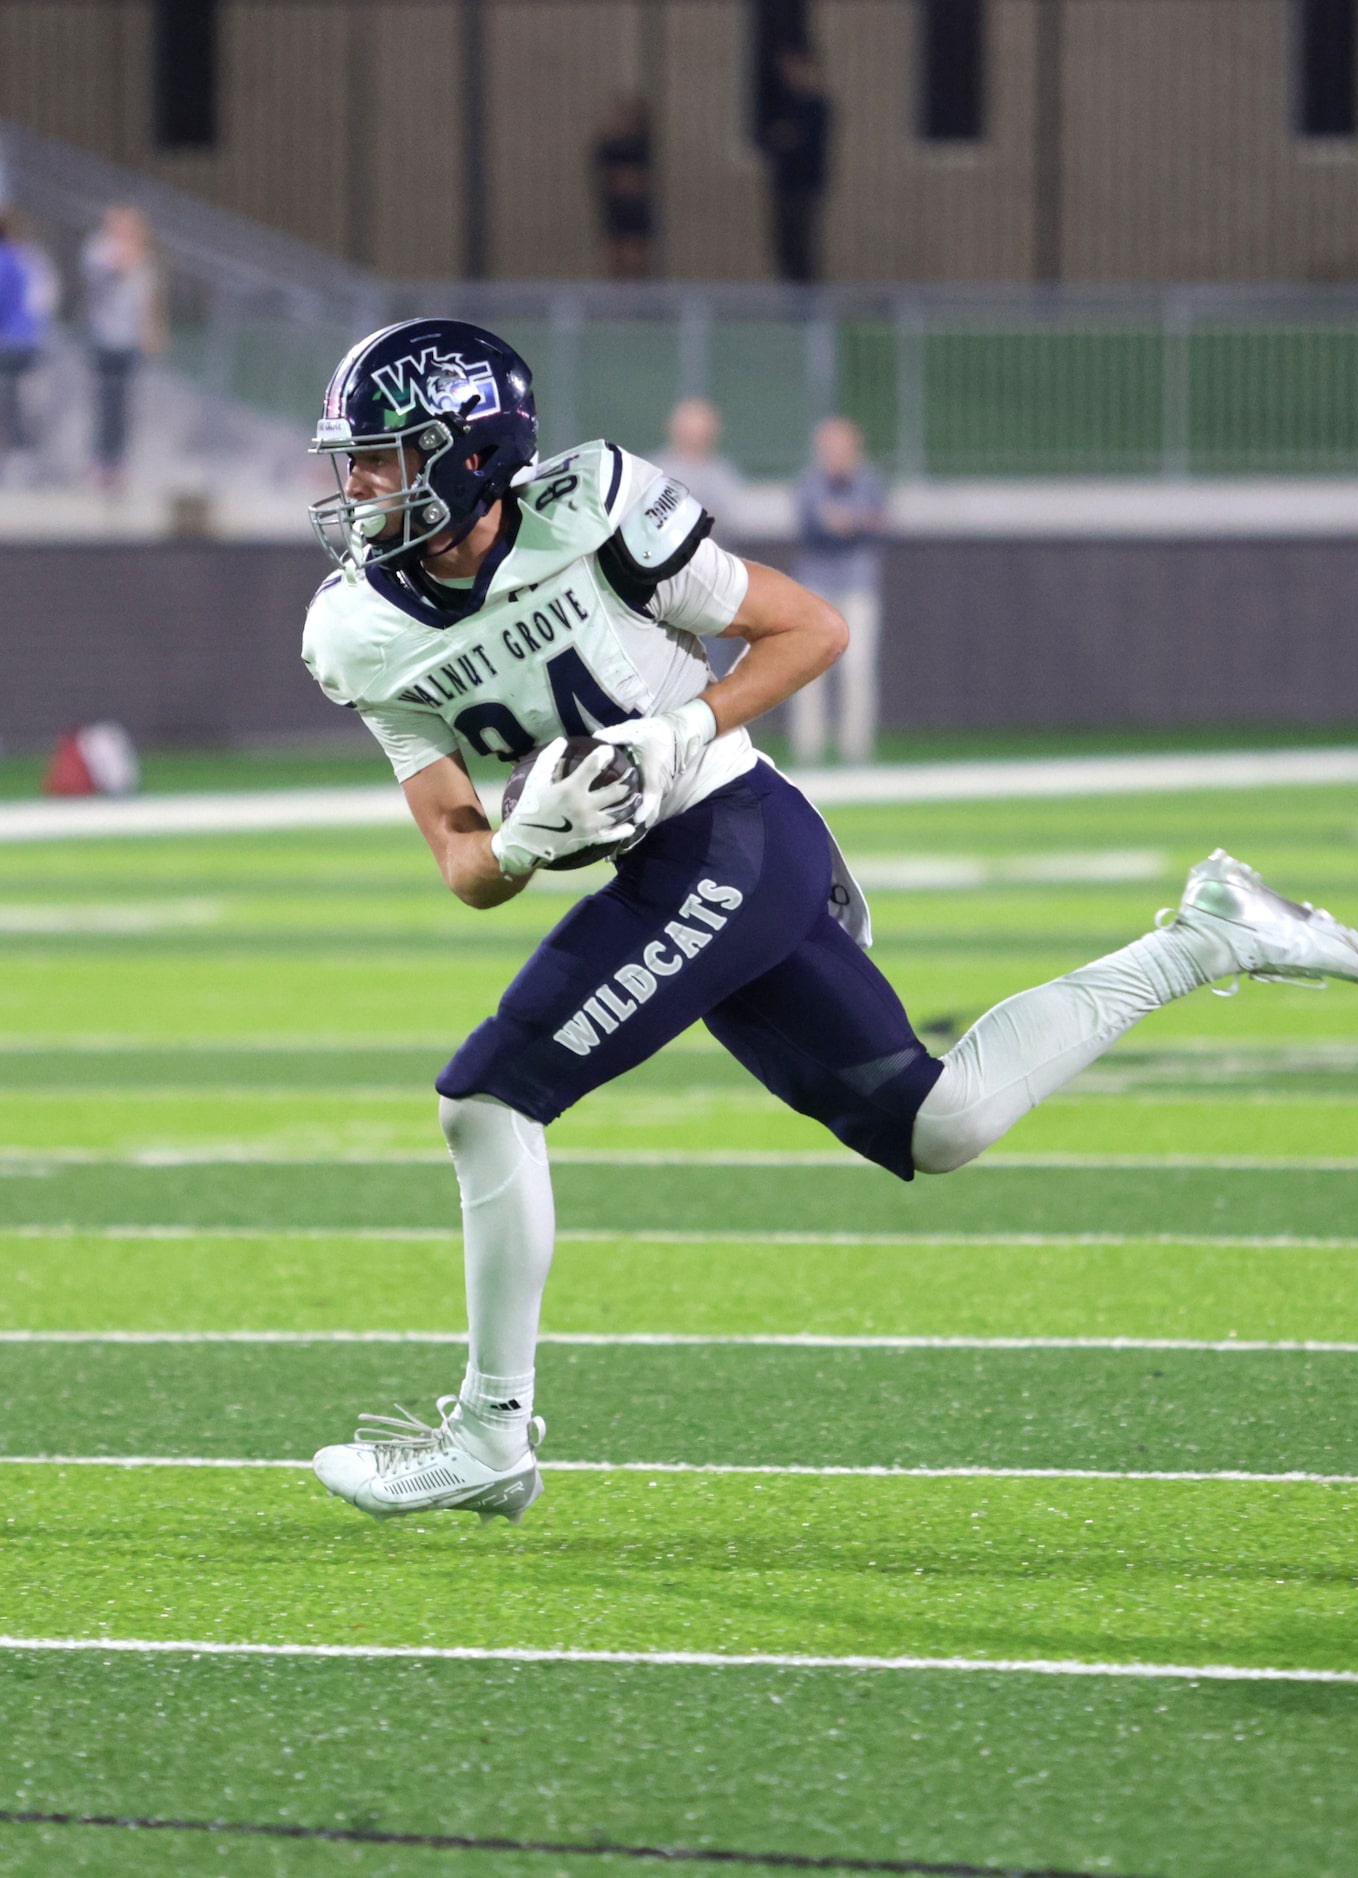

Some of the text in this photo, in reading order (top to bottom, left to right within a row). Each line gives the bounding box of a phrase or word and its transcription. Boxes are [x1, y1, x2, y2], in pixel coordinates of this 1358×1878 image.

[397, 587, 589, 710] WALNUT GROVE
[552, 878, 744, 1057] WILDCATS
